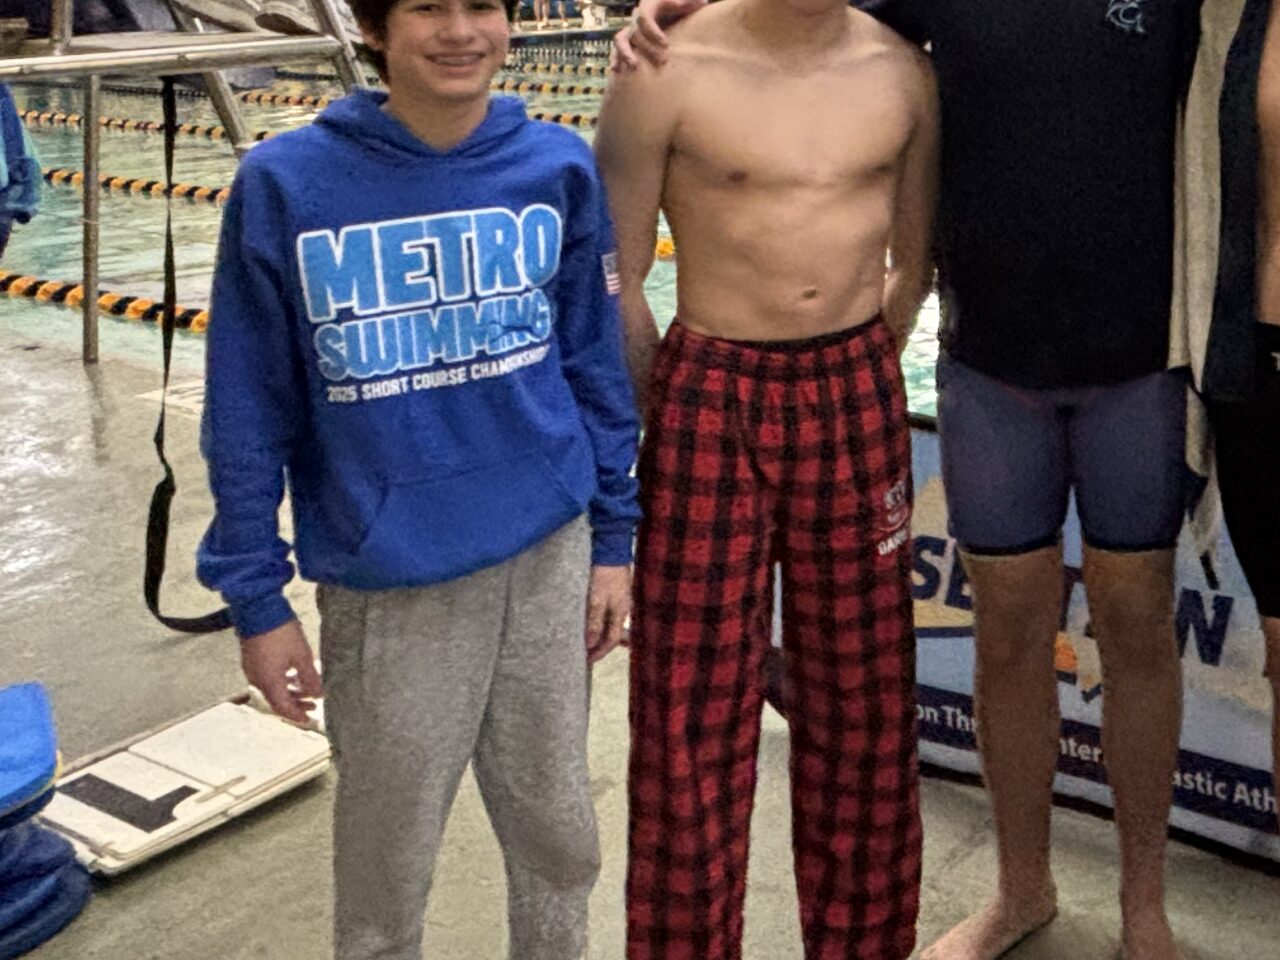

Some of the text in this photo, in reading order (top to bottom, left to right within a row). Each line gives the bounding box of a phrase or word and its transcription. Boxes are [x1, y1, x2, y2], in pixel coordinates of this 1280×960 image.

[296, 203, 563, 323] METRO
[361, 376, 409, 400] SHORT
[412, 365, 467, 391] COURSE
